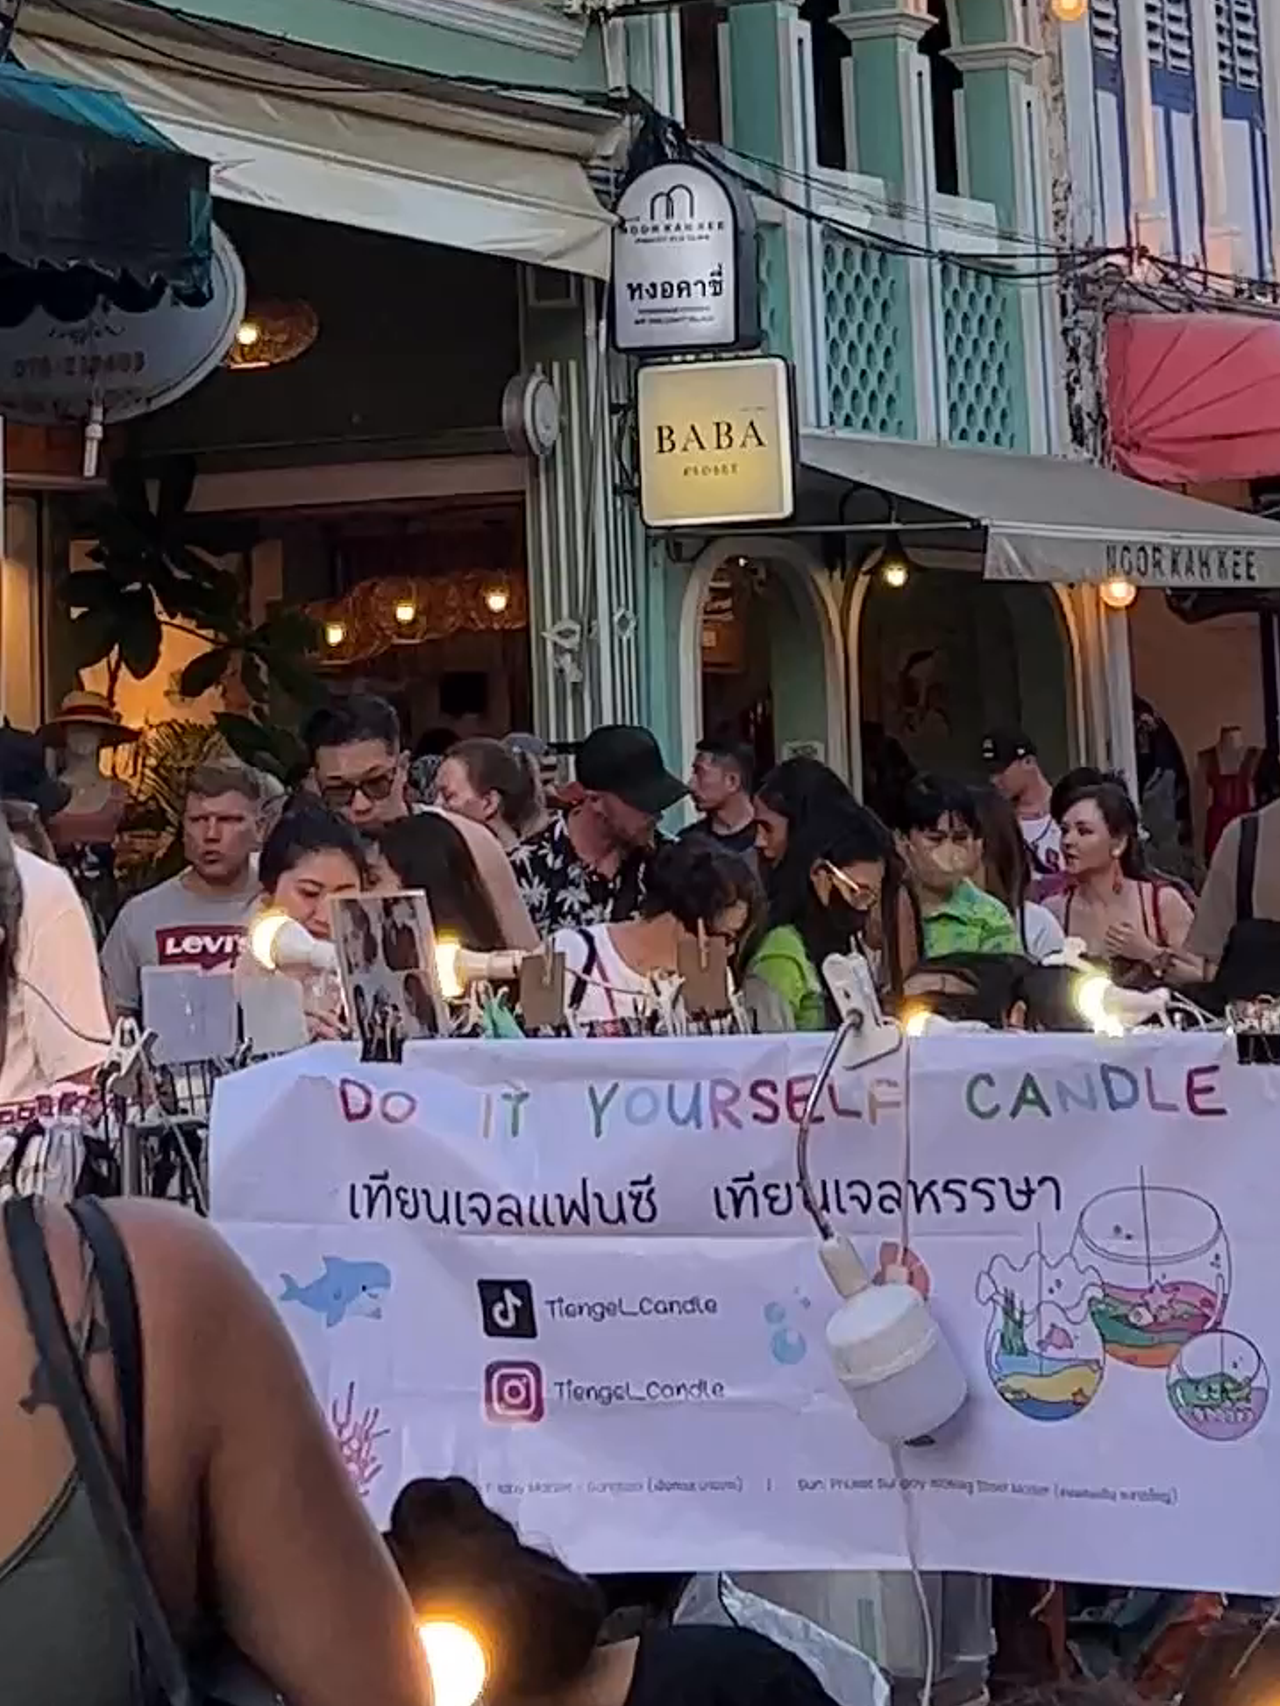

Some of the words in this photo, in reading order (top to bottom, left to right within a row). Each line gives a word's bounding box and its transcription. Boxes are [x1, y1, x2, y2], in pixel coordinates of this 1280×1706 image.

[655, 417, 768, 455] BABA
[337, 1077, 418, 1125] DO
[479, 1090, 531, 1139] IT
[587, 1072, 904, 1138] YOURSELF
[965, 1063, 1229, 1122] CANDLE
[347, 1167, 659, 1228] เทียนเจลแฟนซี
